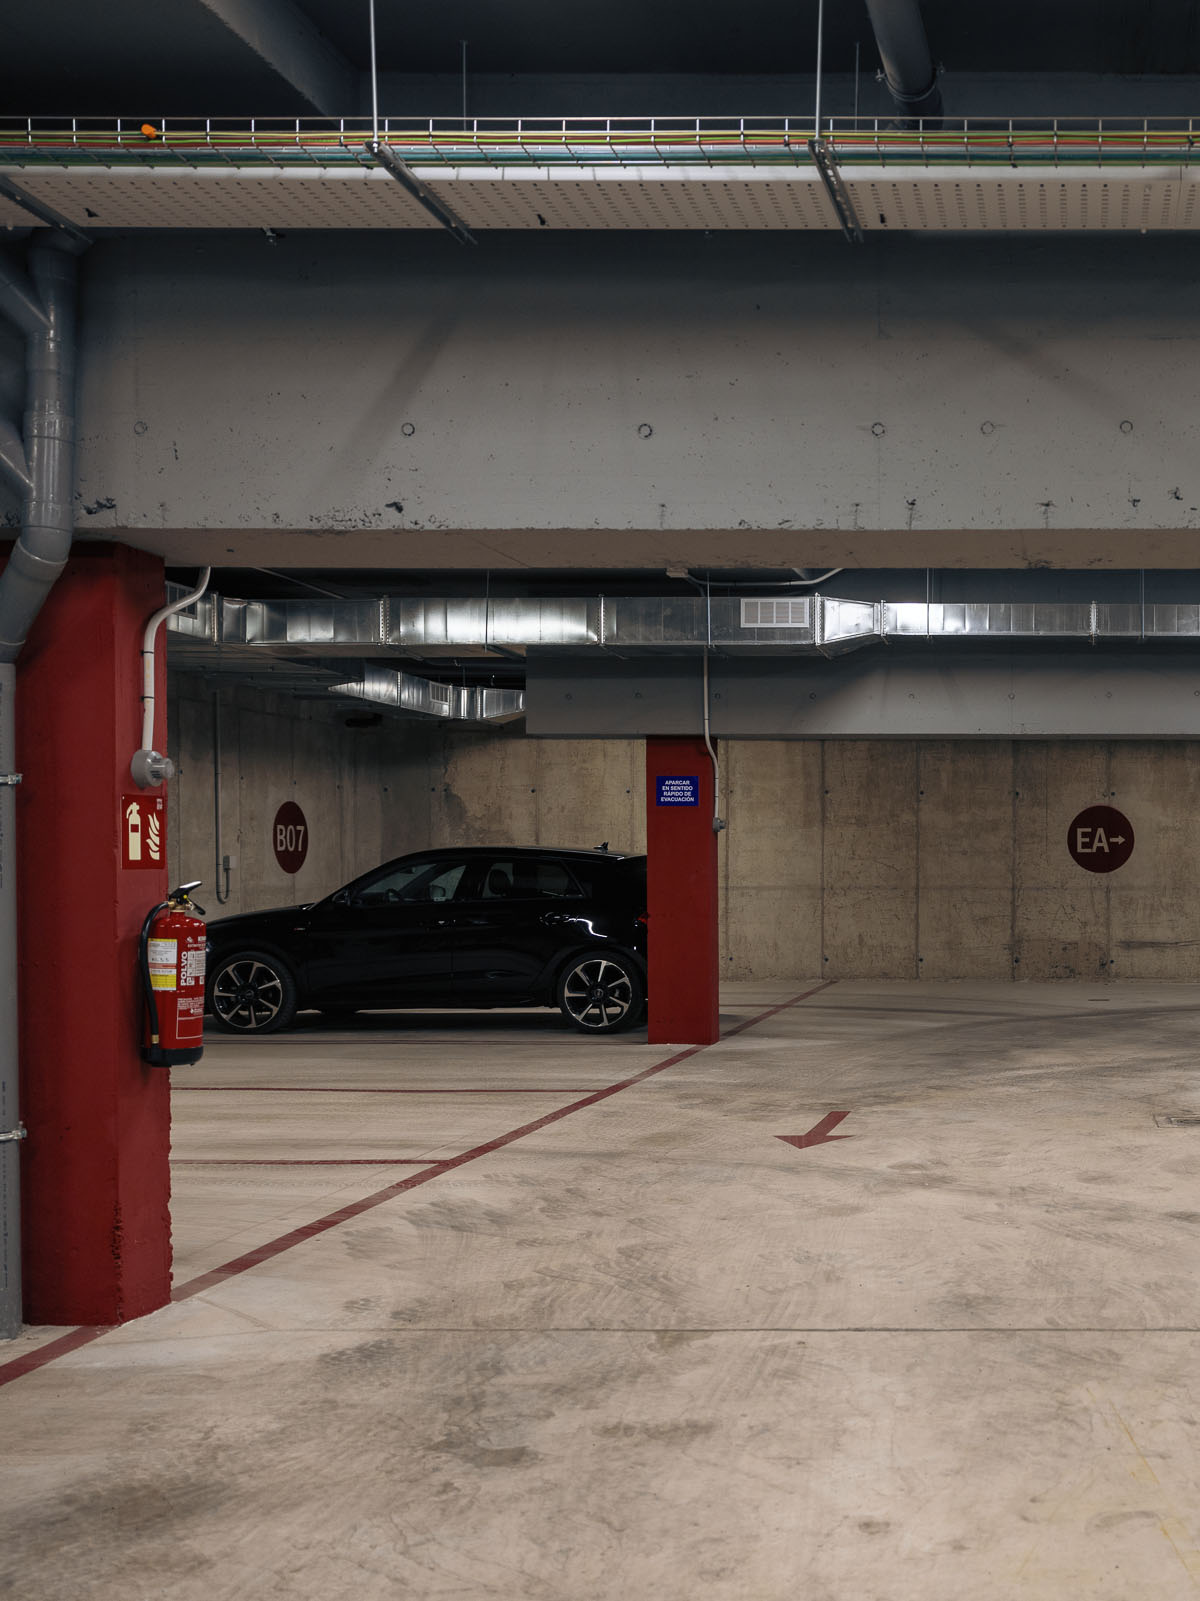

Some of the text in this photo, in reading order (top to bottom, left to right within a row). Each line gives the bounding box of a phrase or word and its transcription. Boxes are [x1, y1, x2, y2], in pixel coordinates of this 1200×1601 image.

[276, 825, 305, 852] B07
[1077, 828, 1110, 853] EA
[180, 951, 188, 986] POLVO
